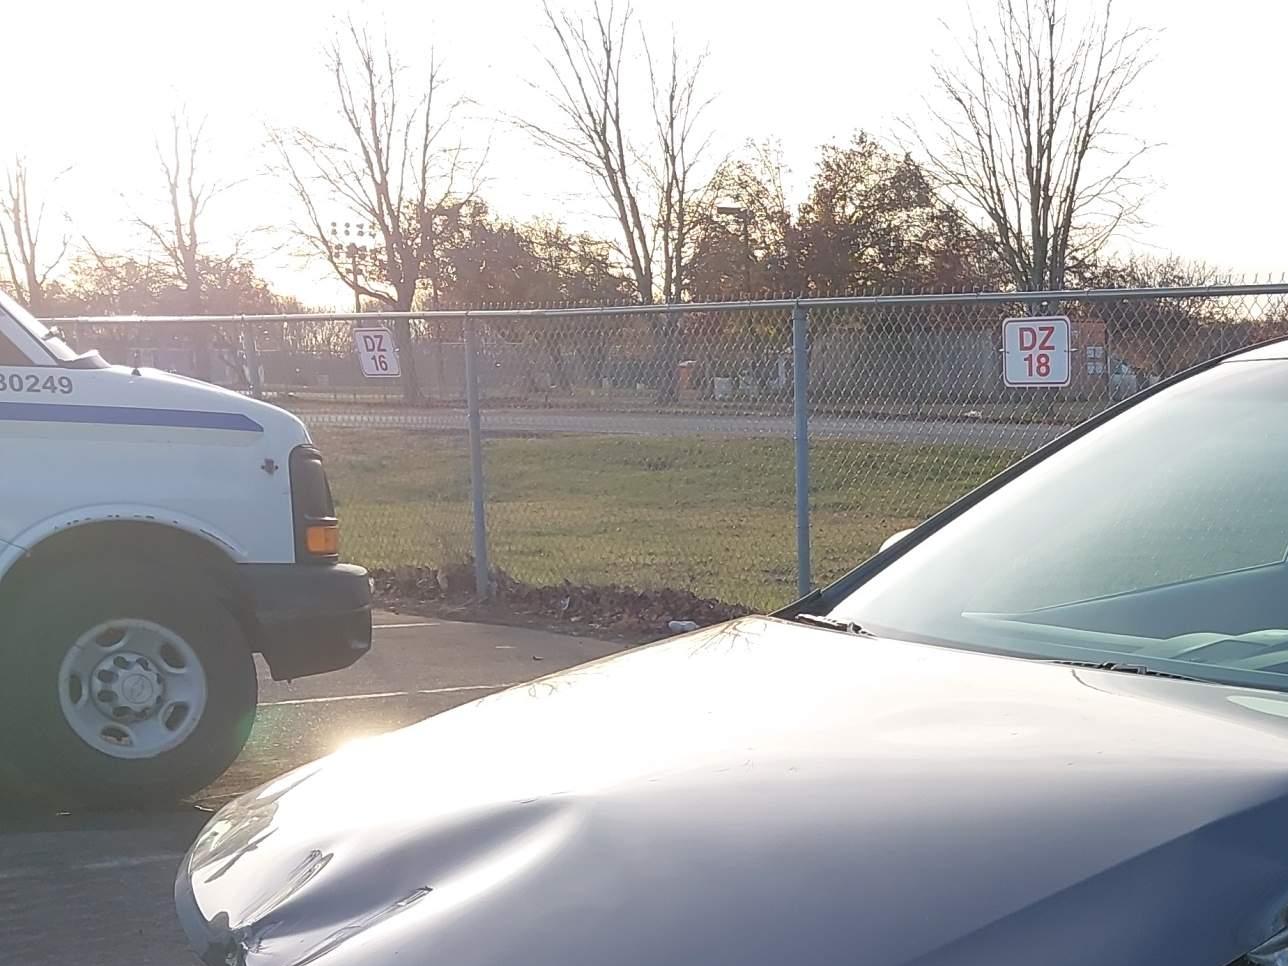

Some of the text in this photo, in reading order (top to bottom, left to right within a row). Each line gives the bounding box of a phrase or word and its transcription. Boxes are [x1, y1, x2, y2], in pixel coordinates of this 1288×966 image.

[362, 334, 387, 352] DZ
[1018, 326, 1055, 351] DZ
[370, 354, 389, 372] 16
[1023, 353, 1051, 377] 18
